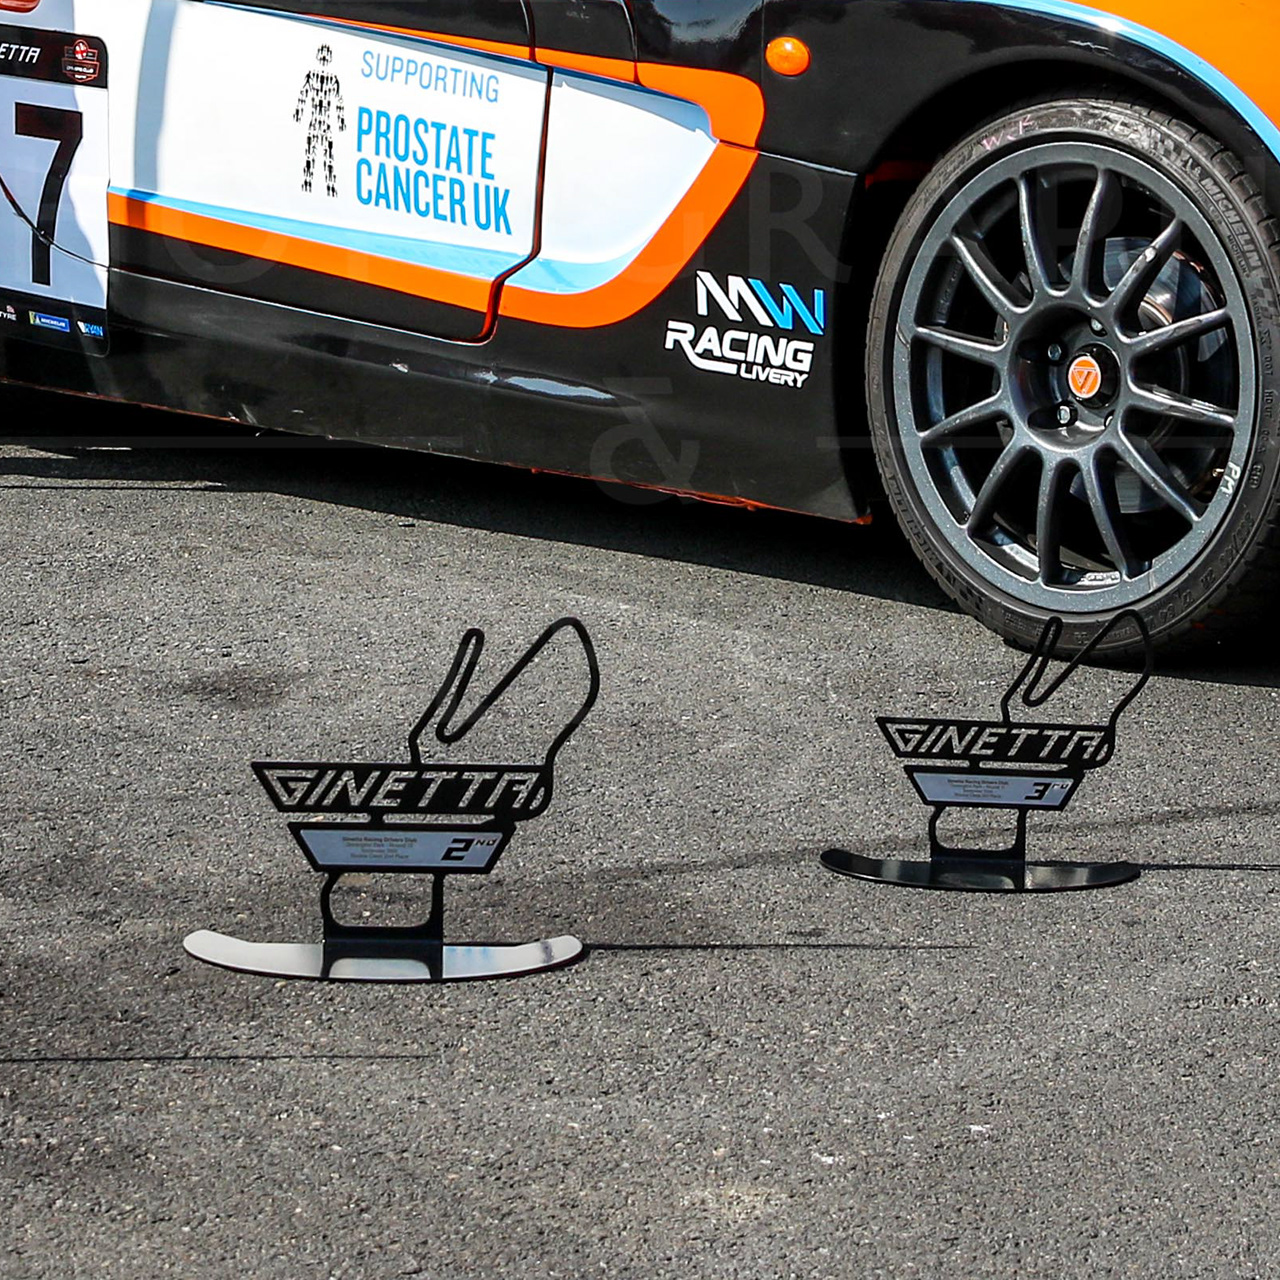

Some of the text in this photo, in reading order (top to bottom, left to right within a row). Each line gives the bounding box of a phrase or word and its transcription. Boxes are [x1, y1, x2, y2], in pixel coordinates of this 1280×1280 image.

[361, 50, 499, 103] SUPPORTING
[356, 106, 496, 180] PROSTATE
[356, 157, 513, 236] CANCER UK
[1200, 176, 1262, 268] MICHELIN
[696, 270, 825, 336] MW
[664, 319, 815, 376] RACING
[739, 362, 809, 389] LIVERY
[885, 723, 1104, 761] GINETTA
[263, 768, 543, 810] GINETTA
